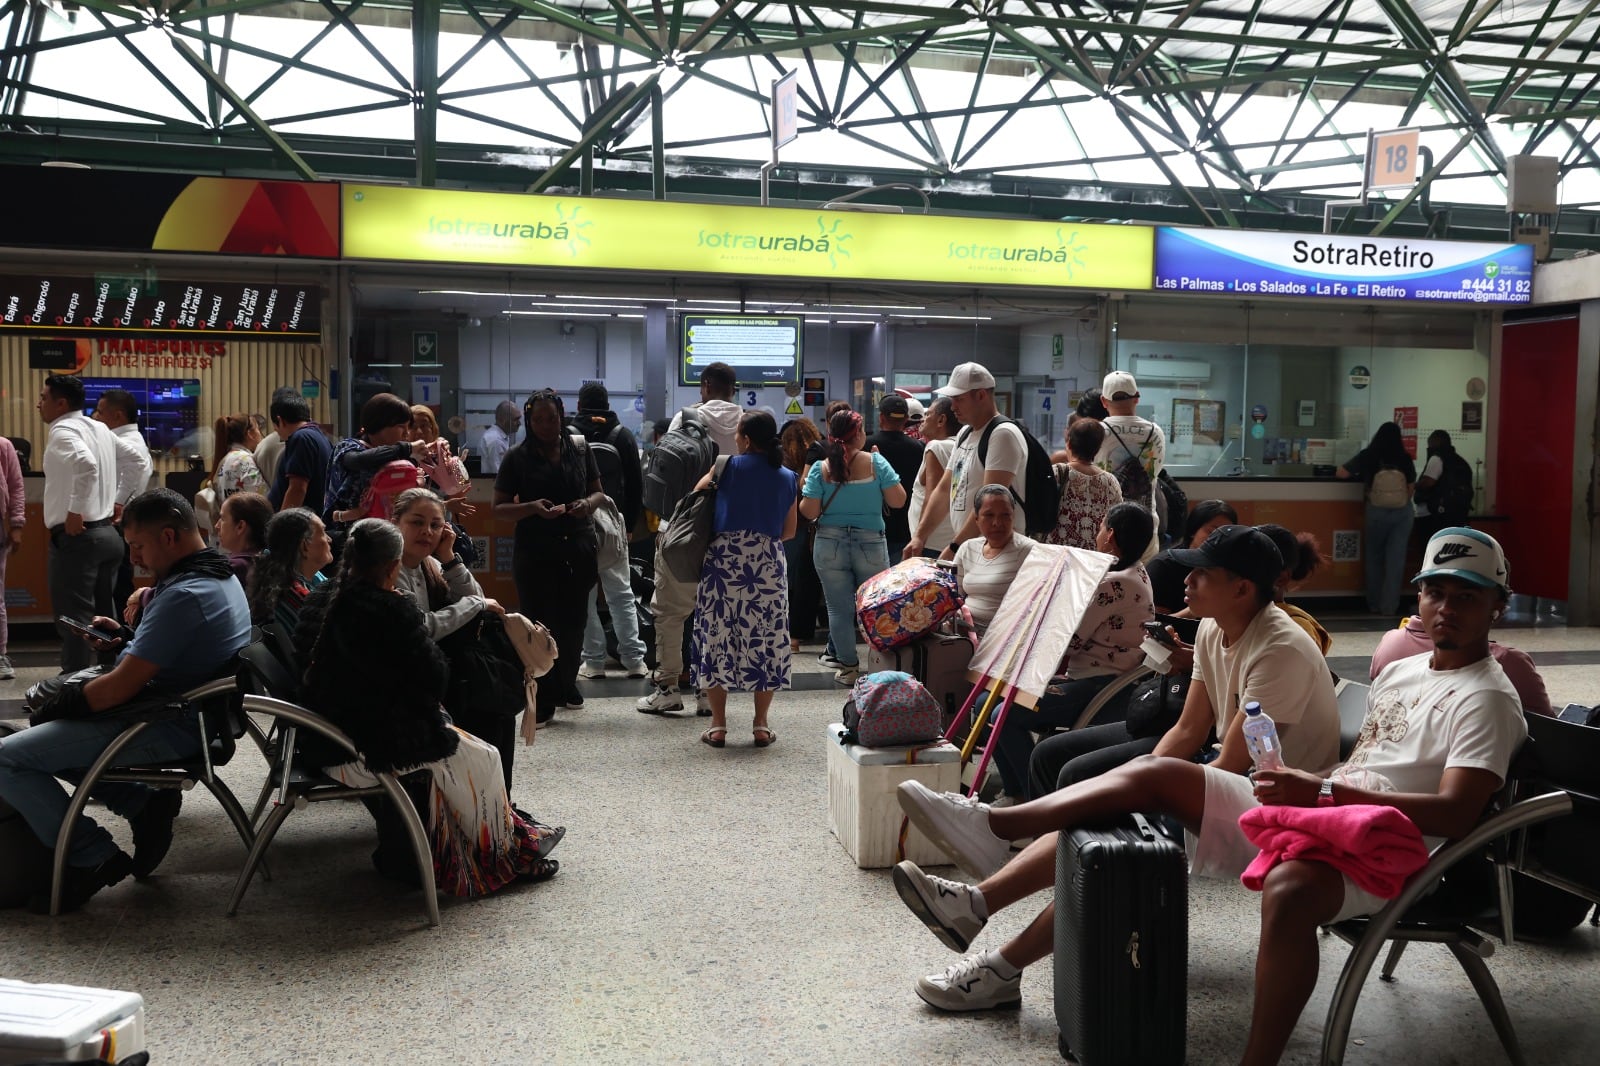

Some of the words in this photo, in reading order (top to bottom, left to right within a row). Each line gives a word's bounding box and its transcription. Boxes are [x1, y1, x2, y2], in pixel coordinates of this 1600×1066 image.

[1385, 144, 1409, 173] 18
[1293, 240, 1434, 269] SotraRetiro
[1155, 276, 1177, 289] Las
[1180, 277, 1225, 291] Palmas
[1234, 279, 1257, 292] Los
[1259, 280, 1307, 294] Salados
[1316, 283, 1331, 295] La
[1333, 283, 1348, 296] Fe
[1357, 284, 1369, 296] El
[1371, 285, 1406, 298] Retiro
[1471, 278, 1495, 292] 444
[1497, 279, 1512, 293] 31
[1515, 280, 1531, 293] 82
[32, 280, 50, 323] Chigorodó
[92, 282, 110, 324] Apartadó
[181, 286, 194, 310] Pedro
[189, 288, 203, 315] Urabá
[239, 288, 251, 309] Juan
[245, 289, 260, 317] Urabá
[1424, 289, 1530, 303] sotraretiro@gmail.com
[5, 296, 19, 322] Bajirá
[63, 292, 80, 324] Carepa
[121, 287, 138, 326] Currulao
[151, 300, 165, 326] Turbo
[207, 294, 223, 328] Necoclí
[261, 288, 278, 328] Arboletes
[289, 290, 305, 329] Montería
[177, 310, 188, 325] San
[186, 315, 197, 327] de
[234, 312, 246, 326] San
[242, 317, 253, 329] de
[98, 339, 226, 357] TRANSPORTES
[141, 356, 197, 369] HERNANDEZ
[422, 386, 430, 401] 1
[747, 391, 757, 406] 3
[1042, 396, 1052, 411] 4
[1440, 543, 1472, 555] NIKE
